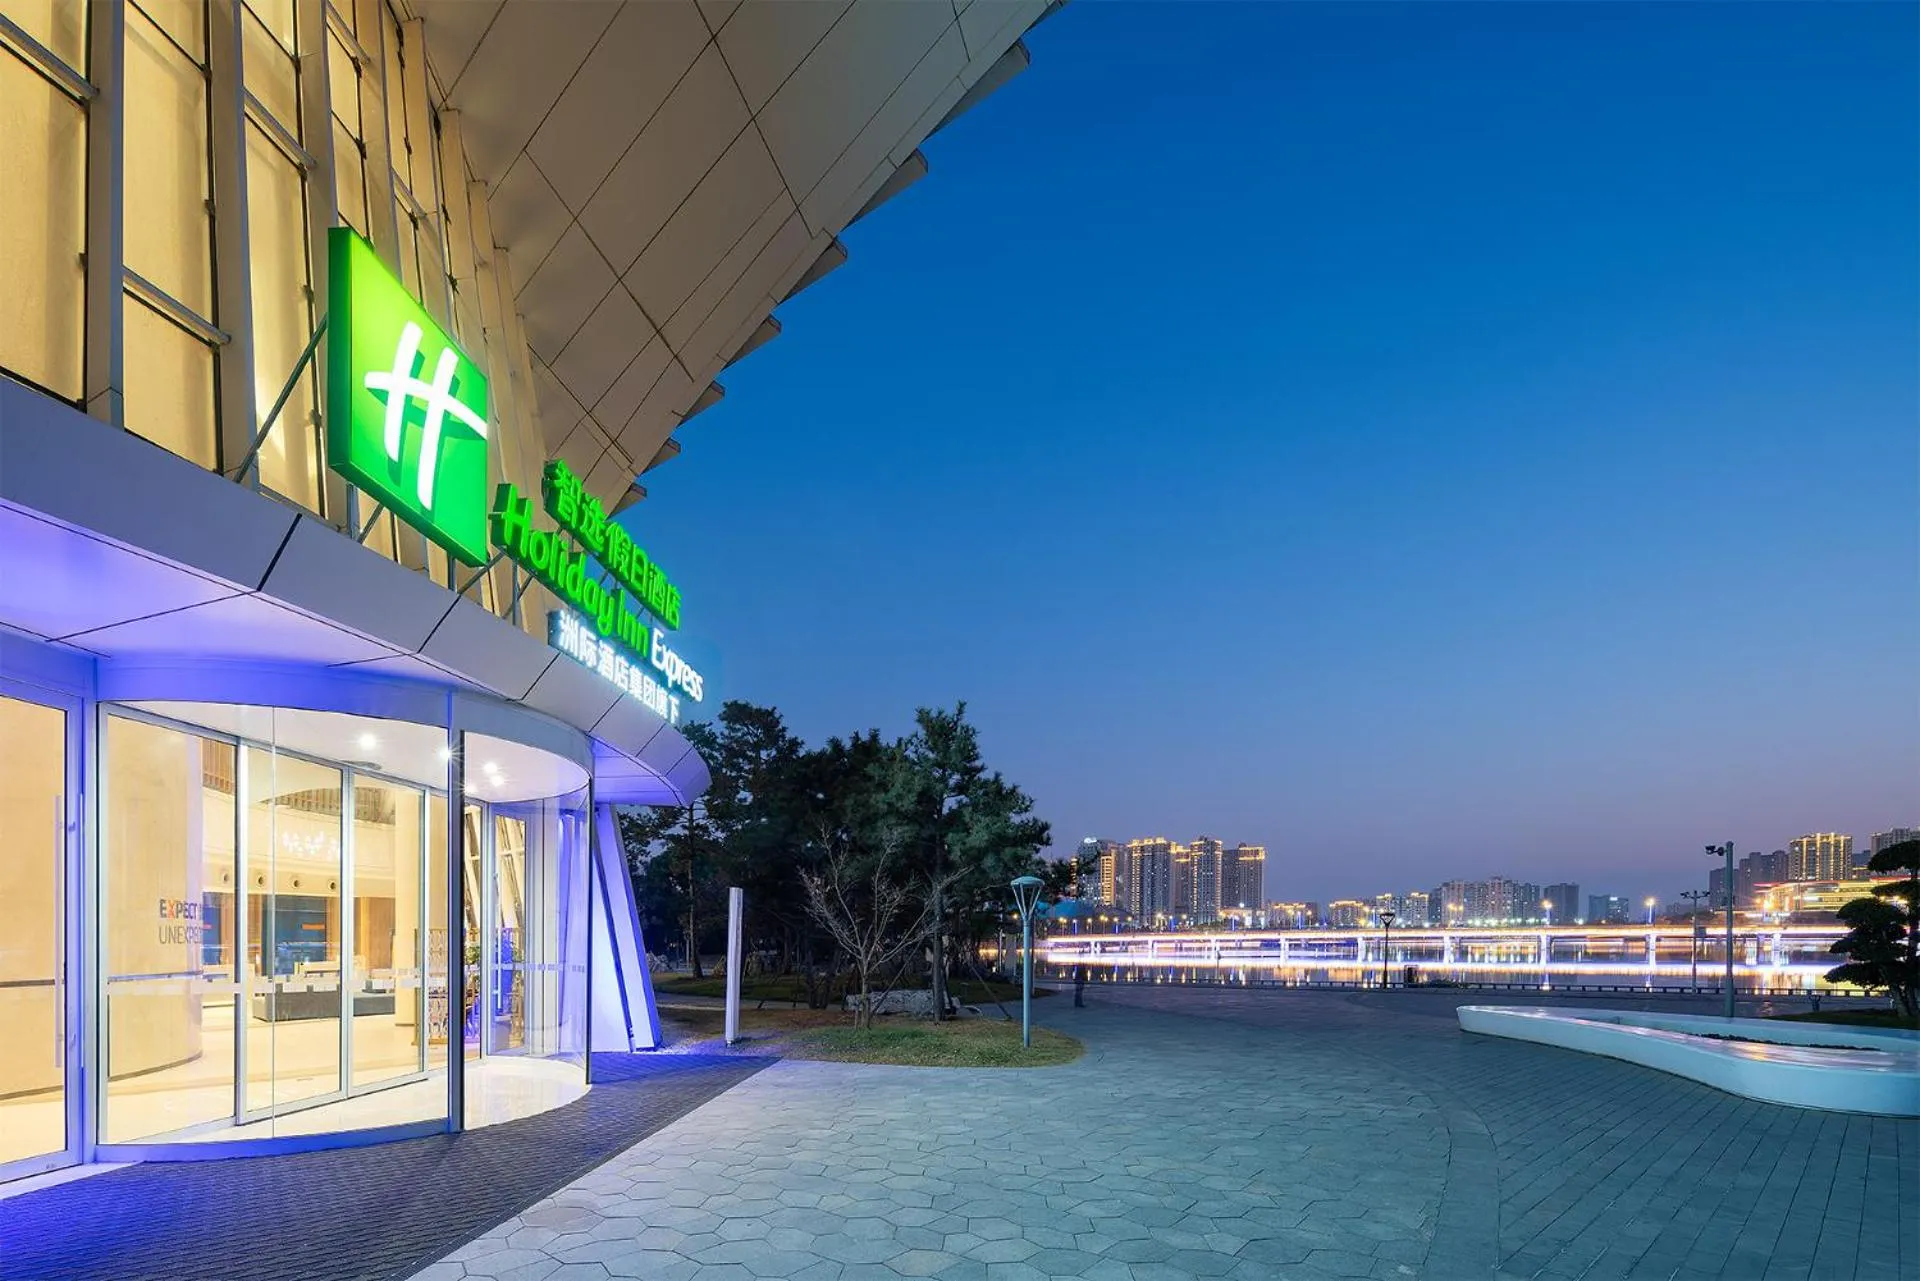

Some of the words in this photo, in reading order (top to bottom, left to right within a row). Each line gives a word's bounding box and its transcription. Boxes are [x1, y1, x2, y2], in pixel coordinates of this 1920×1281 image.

[500, 483, 616, 637] Holiday
[617, 588, 649, 658] Inn
[651, 627, 704, 702] Express
[555, 459, 682, 630] 智选假日酒店
[159, 899, 198, 919] EXPECT
